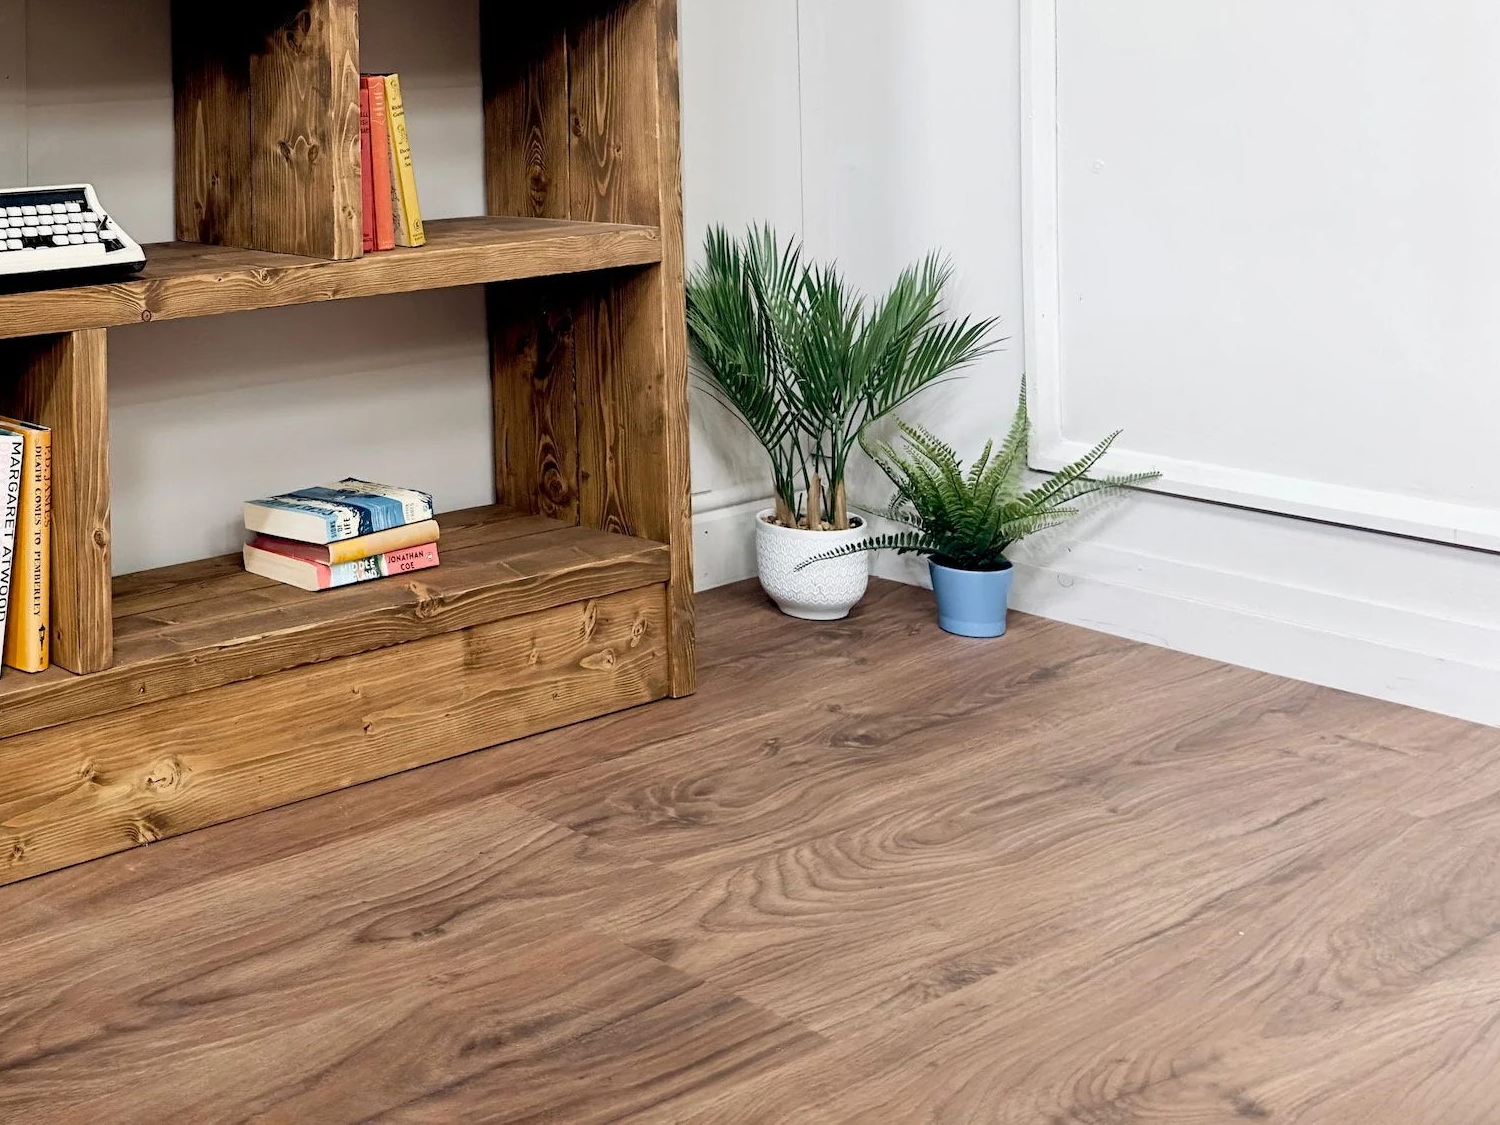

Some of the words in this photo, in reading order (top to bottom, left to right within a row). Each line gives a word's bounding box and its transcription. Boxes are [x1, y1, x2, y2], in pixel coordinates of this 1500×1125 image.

[4, 441, 23, 540] MARGARET
[43, 474, 52, 528] JAMES
[34, 487, 42, 526] COMES
[34, 530, 42, 546] TO
[343, 517, 352, 535] LIFE
[387, 550, 425, 564] JONATHAN
[400, 561, 415, 571] COE
[33, 551, 41, 616] PEMBERLEY
